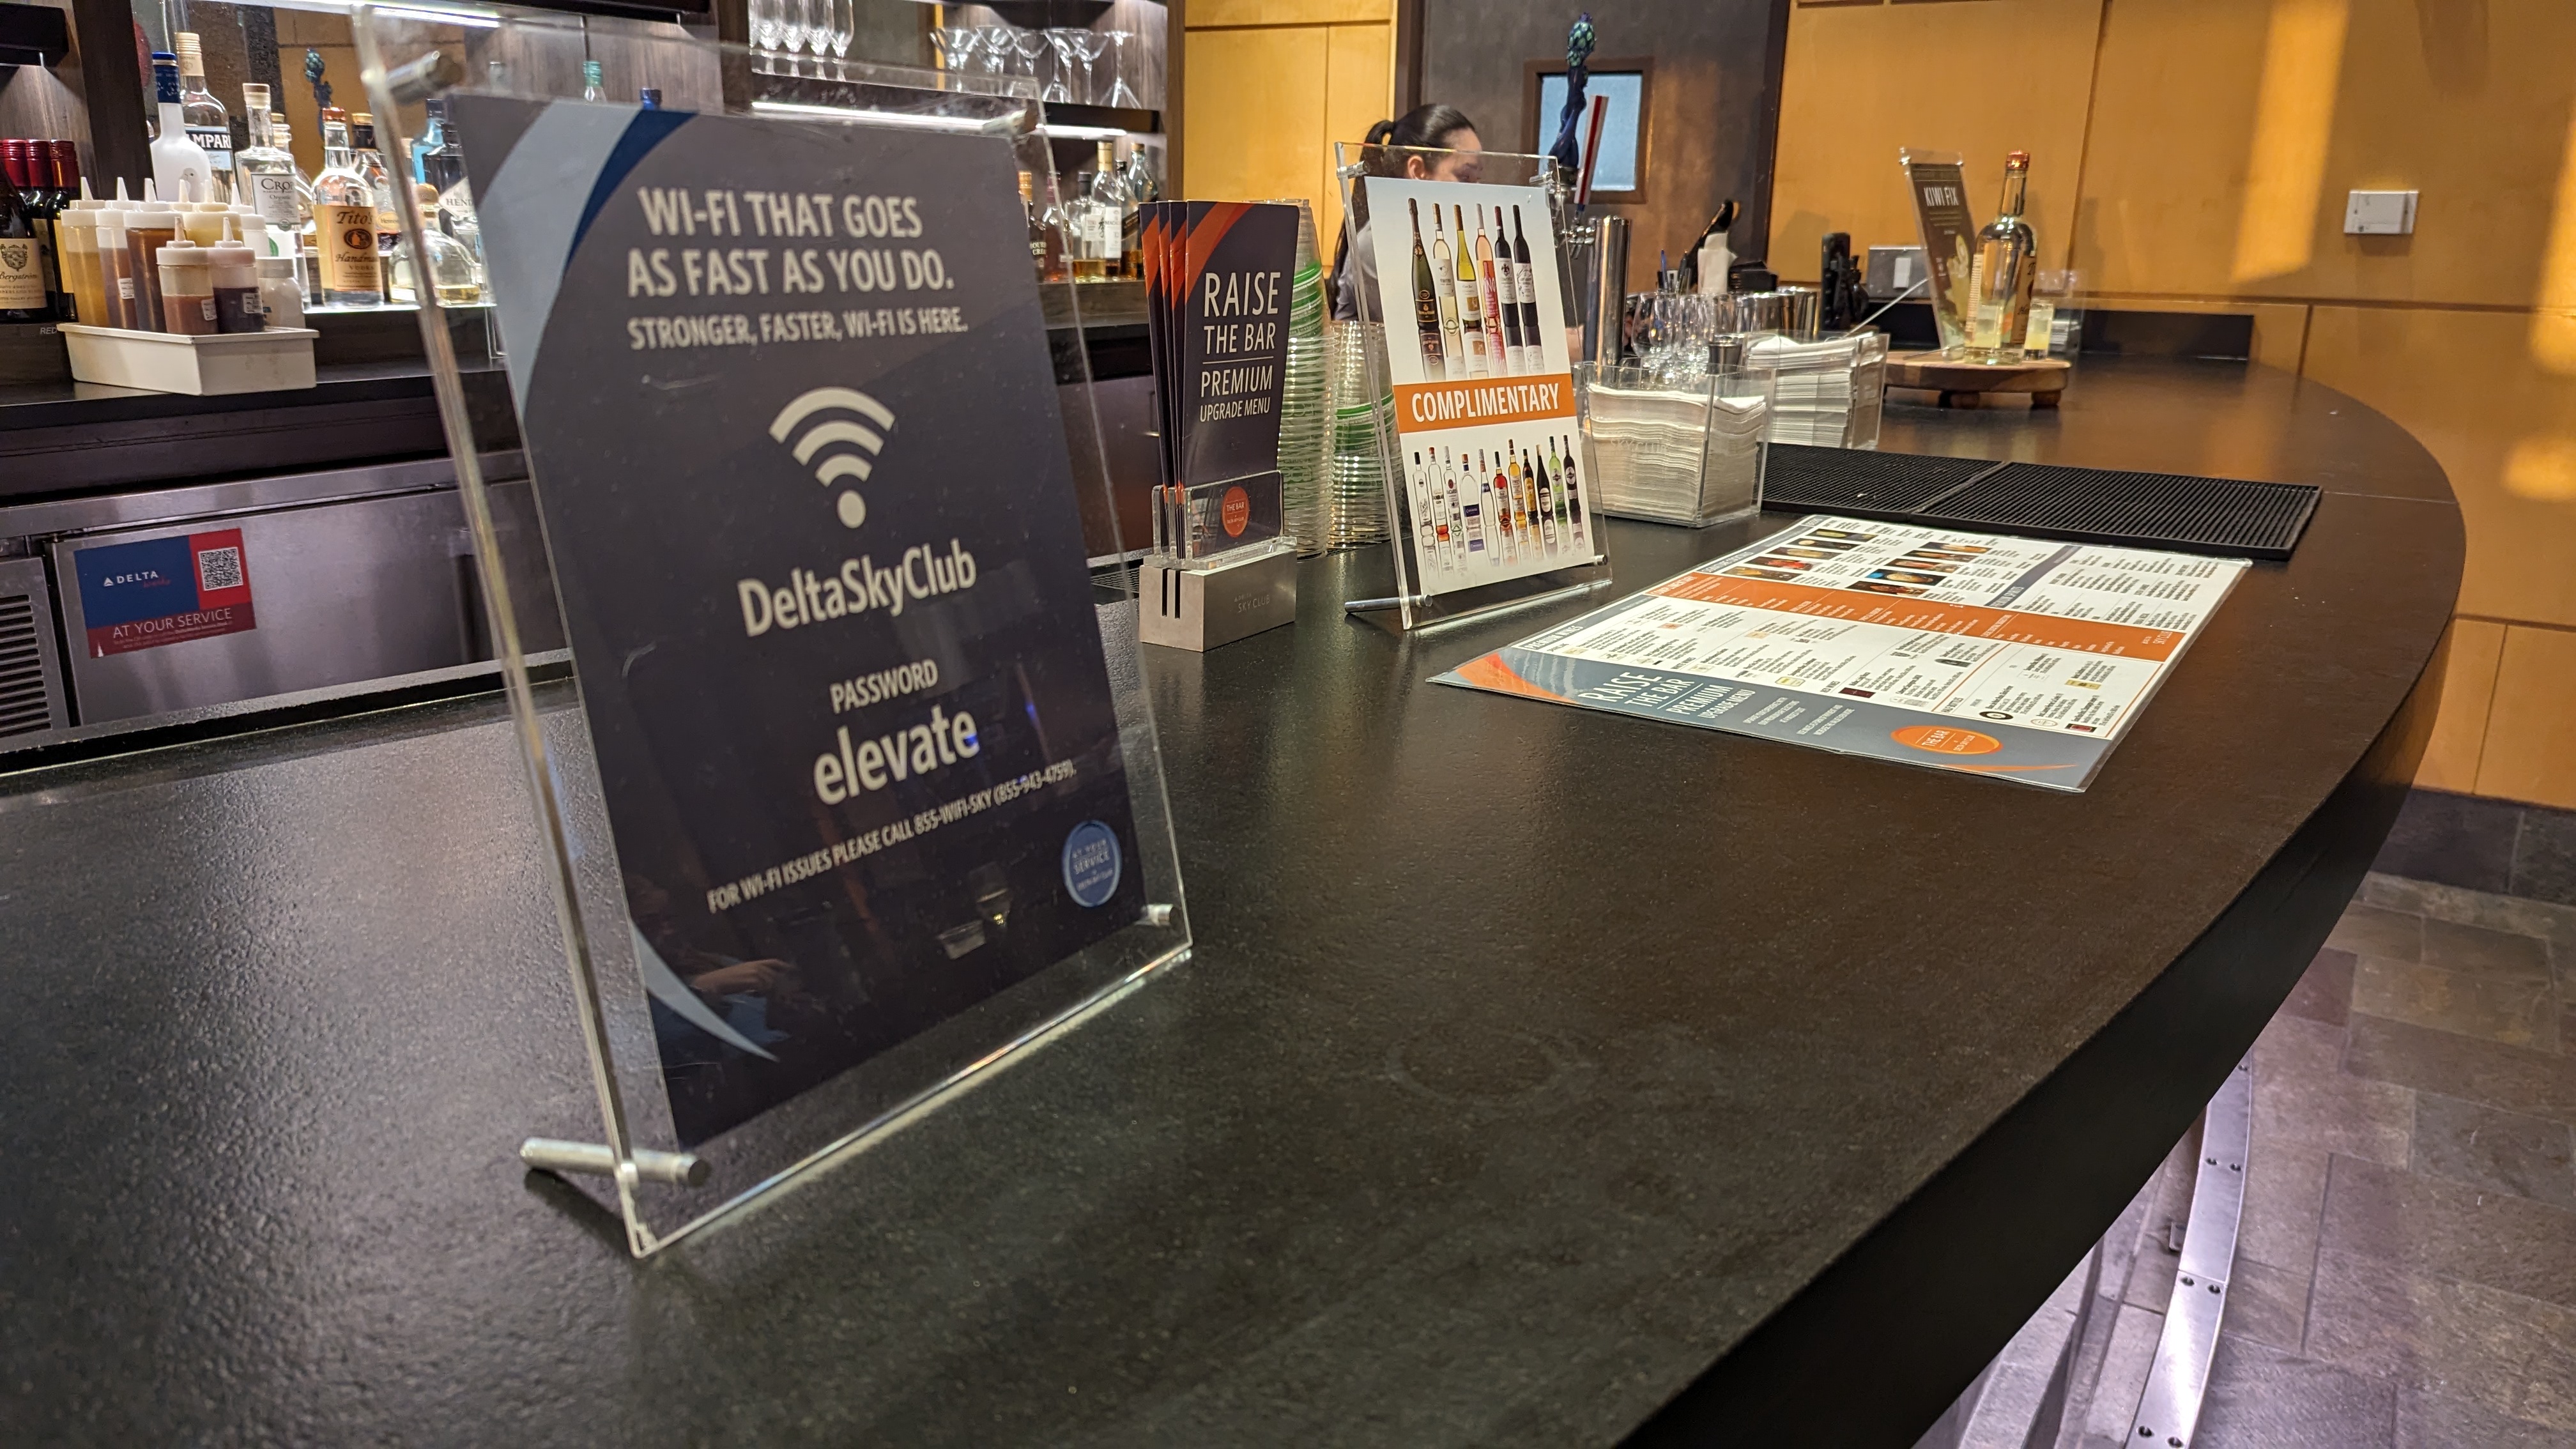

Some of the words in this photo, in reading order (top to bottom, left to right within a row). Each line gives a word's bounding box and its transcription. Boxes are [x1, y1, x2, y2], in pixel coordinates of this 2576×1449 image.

[186, 134, 231, 149] MPARI
[1924, 187, 1945, 206] KIWI
[1944, 187, 1959, 206] FIX
[638, 187, 740, 236] WI-FI
[744, 193, 833, 238] THAT
[843, 195, 923, 238] GOES
[628, 249, 677, 297] AS
[683, 249, 770, 296] FAST
[783, 249, 825, 295] AS
[827, 249, 896, 293] YOU
[901, 249, 954, 291] DO.
[1204, 272, 1280, 317] RAISE
[40, 326, 57, 335] RED
[627, 317, 758, 350] STRONGER,
[760, 312, 842, 344] FASTER,
[843, 309, 896, 339] WI-FI
[897, 309, 917, 335] IS
[918, 307, 969, 334] HERE.
[1204, 324, 1238, 354] THE
[1245, 322, 1276, 351] BAR
[1201, 365, 1273, 397] PREMIUM
[1200, 401, 1243, 422] UPGRADE
[1244, 397, 1271, 416] MENU
[1412, 383, 1559, 422] COMPLIMENTARY
[1226, 503, 1236, 512] THE
[1236, 502, 1245, 510] BAR
[117, 571, 159, 584] DELTA
[737, 538, 977, 636] DeltaSkyClub
[1238, 599, 1251, 613] SKY
[1253, 594, 1271, 608] CLUB
[113, 625, 130, 639] AT
[135, 618, 174, 633] YOUR
[178, 608, 233, 627] SERVICE
[1555, 625, 1583, 636] WINES
[830, 659, 938, 714] PASSWORD
[1578, 672, 1663, 702] RAISE
[1625, 692, 1669, 707] THE
[1660, 678, 1694, 695] BAR
[1666, 685, 1733, 715] PREMIUM
[1698, 700, 1734, 719] UPGRADE
[1729, 689, 1756, 704] MENU
[1922, 737, 1942, 746] THE
[1931, 730, 1950, 739] BAR
[814, 704, 979, 806] elevate
[707, 882, 741, 914] FOR
[740, 866, 782, 900] WI-FI
[781, 848, 832, 884] ISSUES
[831, 830, 882, 866] PLEASE
[882, 819, 914, 847] CALL
[914, 788, 992, 835] 855-WIFI-SKY
[1074, 851, 1110, 875] SERVICE
